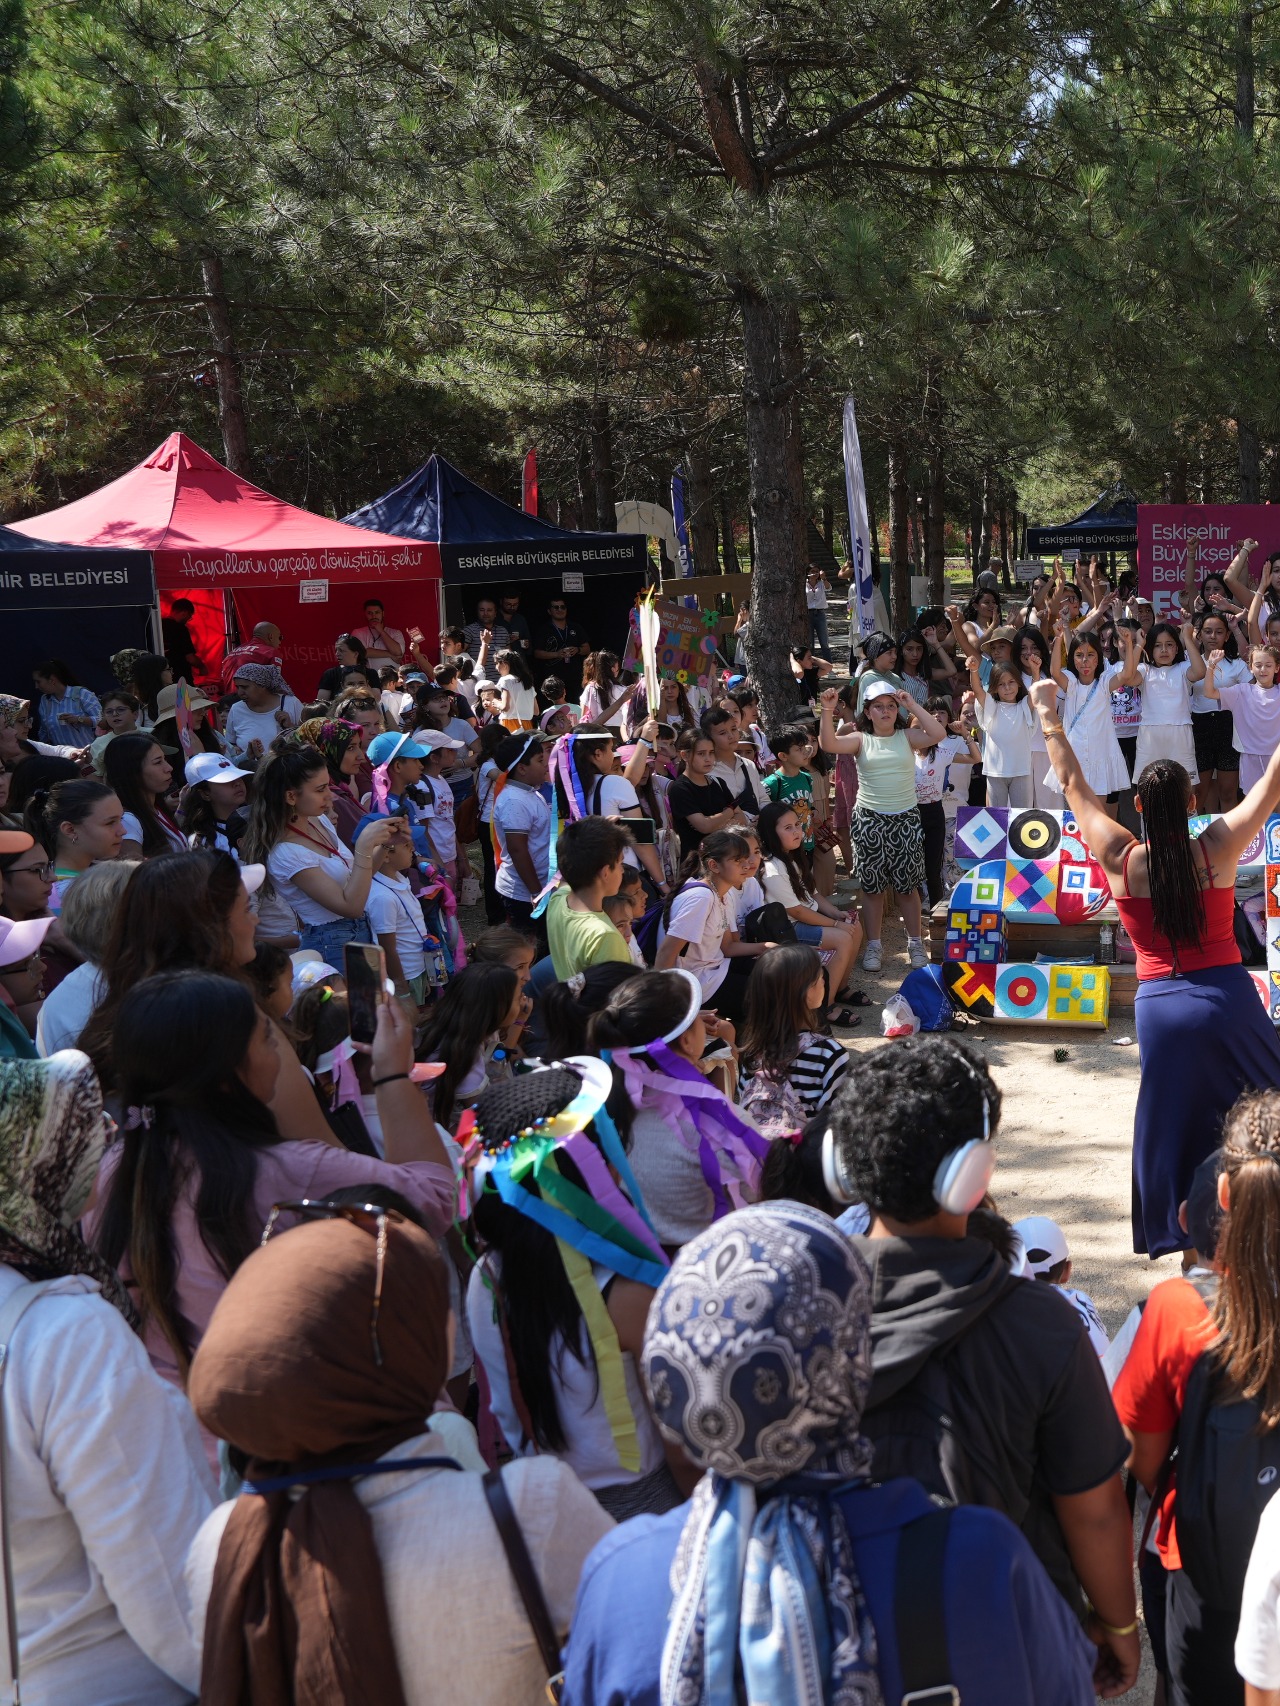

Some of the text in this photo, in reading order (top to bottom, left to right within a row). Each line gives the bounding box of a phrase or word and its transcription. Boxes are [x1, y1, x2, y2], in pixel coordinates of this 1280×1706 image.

[1039, 536, 1084, 545] ESKİŞEHİR
[179, 546, 422, 581] Hayallerin gerçeğe dönüştüğü şehir
[458, 546, 635, 569] ESKİŞEHİR BÜYÜKŞEHİR BELEDİYESİ
[29, 567, 129, 587] BELEDİYESİ
